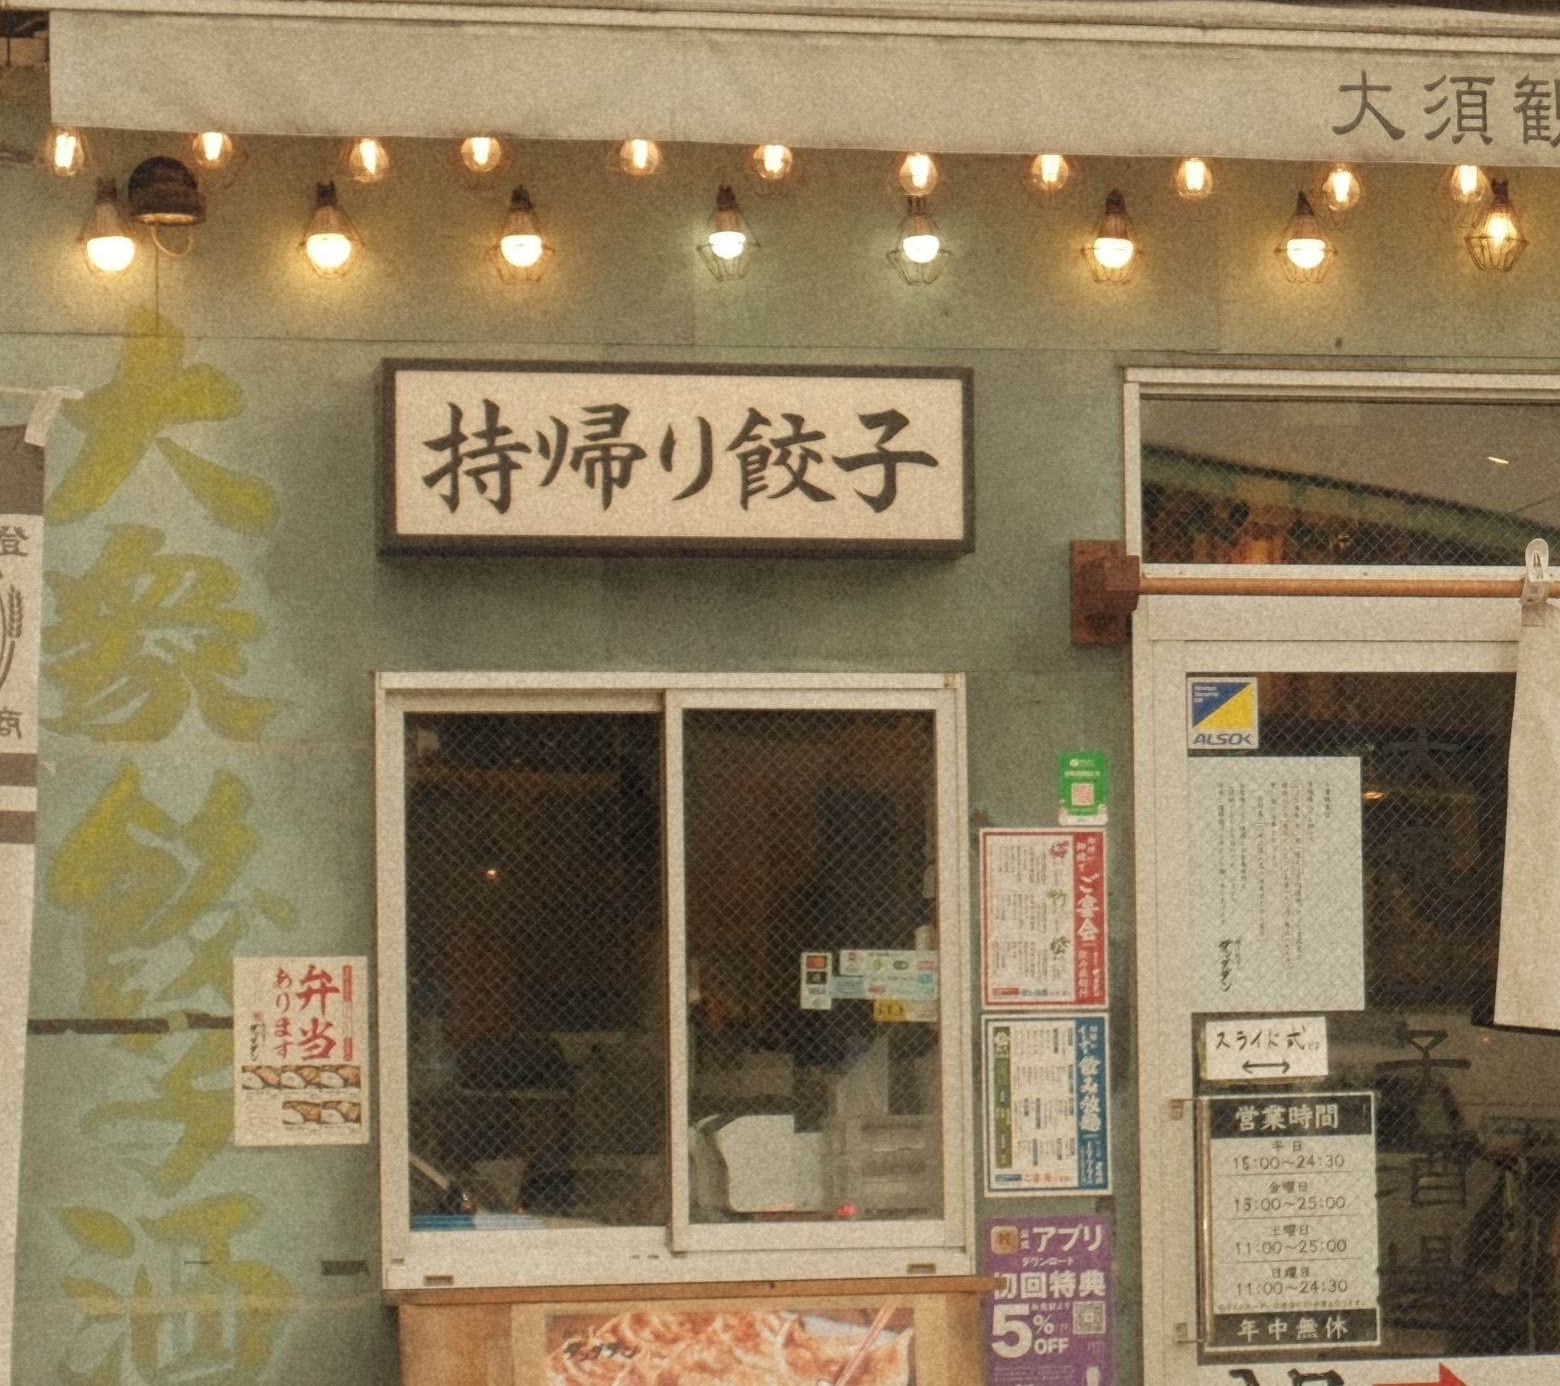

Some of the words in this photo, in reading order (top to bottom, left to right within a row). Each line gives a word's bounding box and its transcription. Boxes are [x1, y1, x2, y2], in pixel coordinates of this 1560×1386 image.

[422, 398, 940, 515] 持帰り餃子
[1192, 732, 1253, 746] ALSOK
[272, 967, 293, 1059] あります
[295, 964, 341, 1061] 弁当
[1234, 1103, 1339, 1131] 営業時間
[1268, 1180, 1309, 1193] 金曜日
[1032, 1223, 1102, 1253] アプリ
[1270, 1224, 1310, 1237] 土曜日
[1021, 1256, 1074, 1268] ダウンロード
[1271, 1266, 1311, 1279] 日曜日
[991, 1303, 1033, 1359] 5
[1237, 1316, 1349, 1342] 年中無休
[1033, 1337, 1070, 1355] OFF
